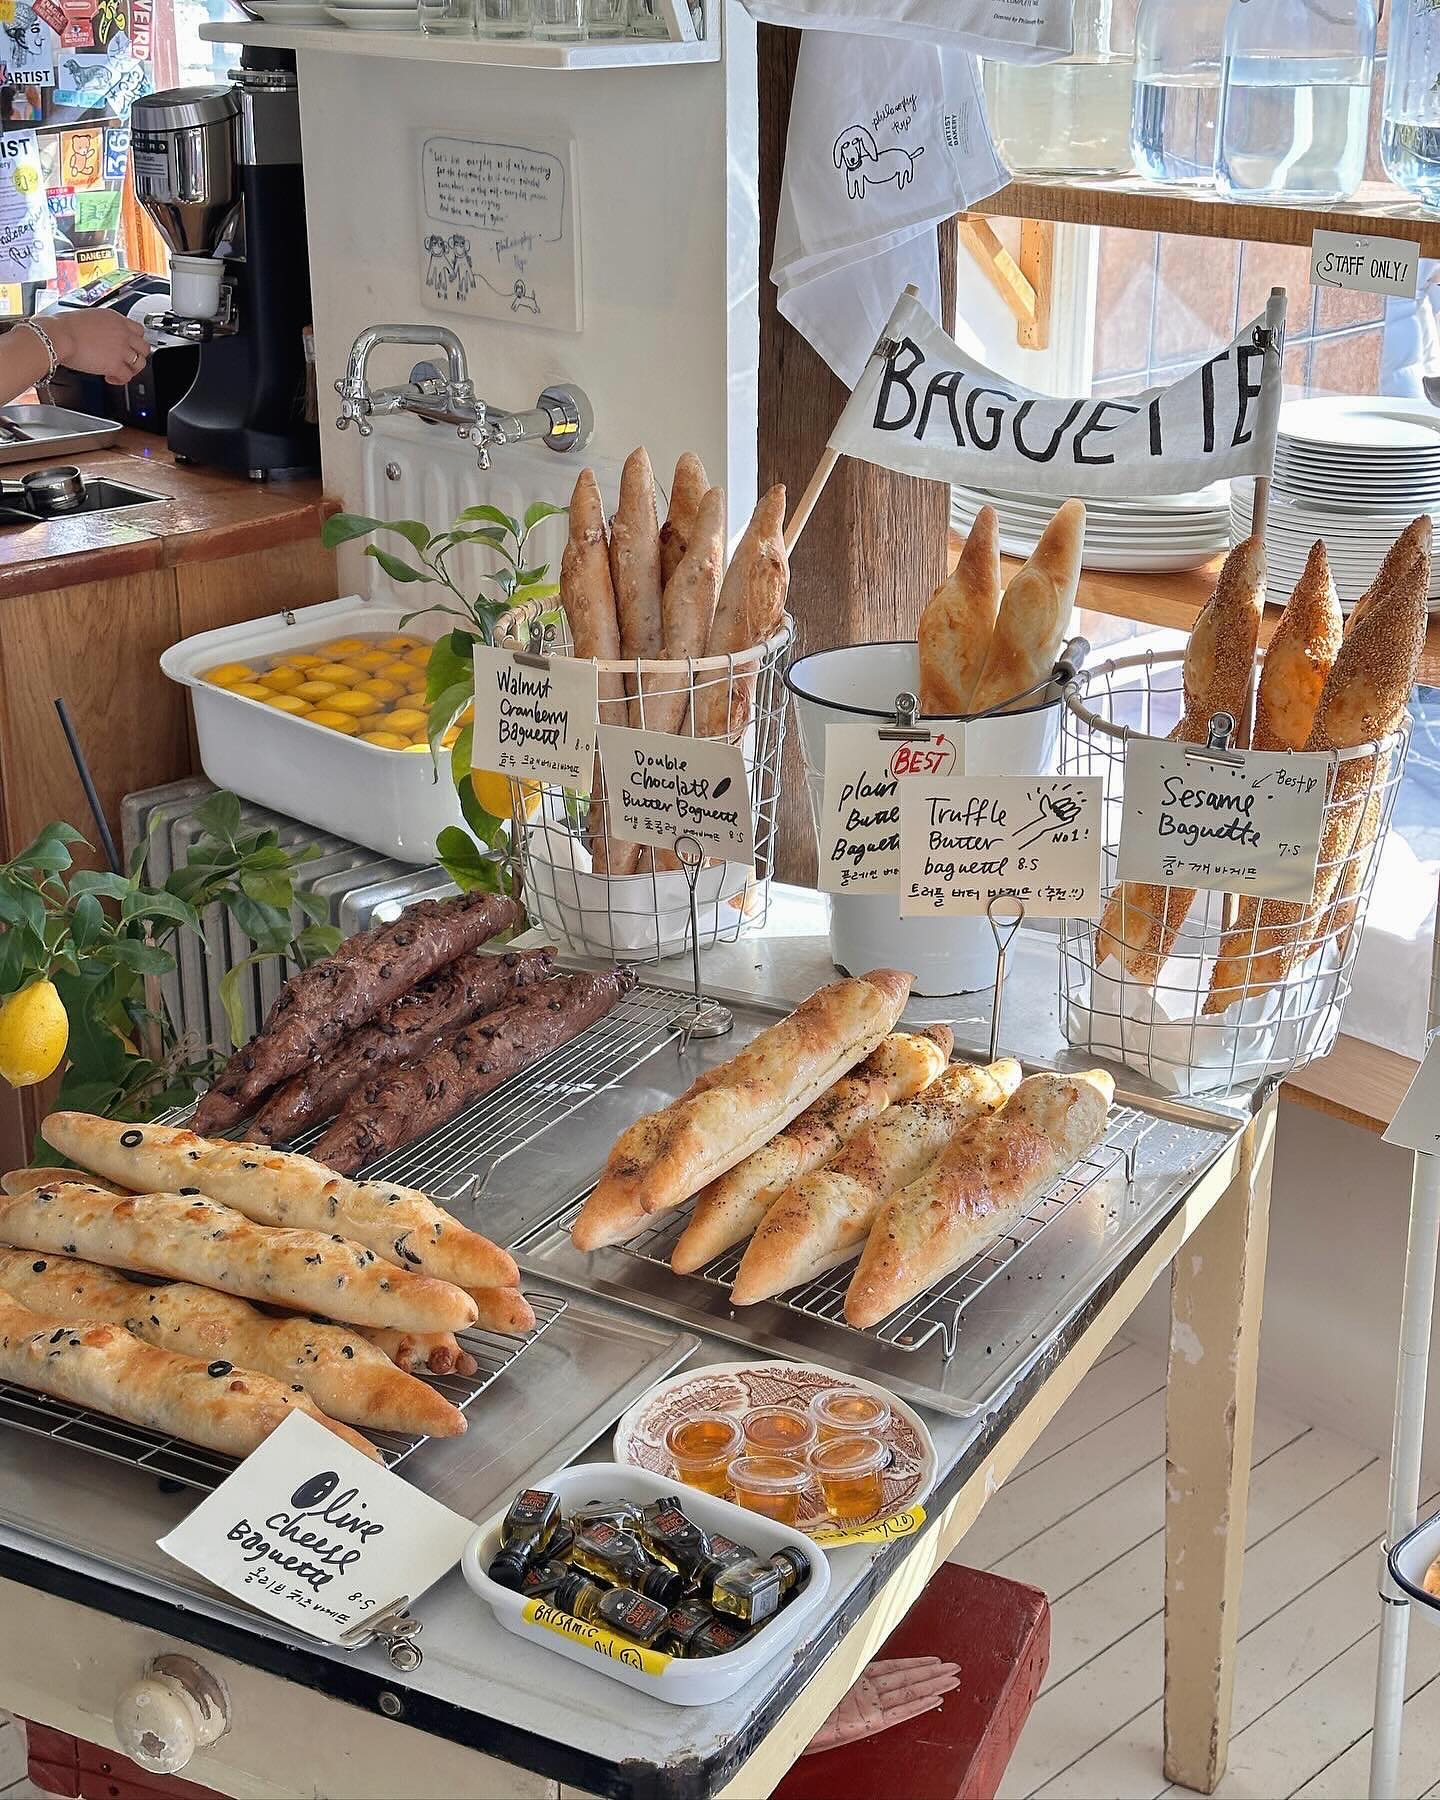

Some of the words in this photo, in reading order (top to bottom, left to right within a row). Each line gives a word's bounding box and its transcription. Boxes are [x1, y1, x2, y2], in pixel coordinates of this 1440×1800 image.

[1324, 252, 1364, 275] STAFF
[1370, 259, 1408, 282] ONLY!
[873, 336, 1264, 464] BAGUETTE
[497, 666, 552, 698] Walnut
[499, 719, 560, 750] Baguette
[634, 750, 688, 772] Double
[893, 748, 950, 775] BEST
[1276, 769, 1306, 793] Best
[622, 789, 673, 811] Butter
[676, 797, 738, 826] Baguette
[1161, 776, 1256, 817] Sesame
[845, 806, 900, 831] Butte
[925, 797, 1007, 827] Truffle
[929, 831, 1005, 851] Butter
[1159, 813, 1261, 848] Baguette
[1278, 842, 1300, 857] 7.5
[840, 869, 878, 886] 플레인
[924, 857, 1009, 882] baguette
[1017, 857, 1040, 871] 8.5
[908, 883, 945, 908] 트러플
[951, 887, 980, 900] 버터
[226, 1518, 336, 1594] Baguette
[244, 1566, 287, 1595] 올리브
[347, 1592, 376, 1611] 8.5
